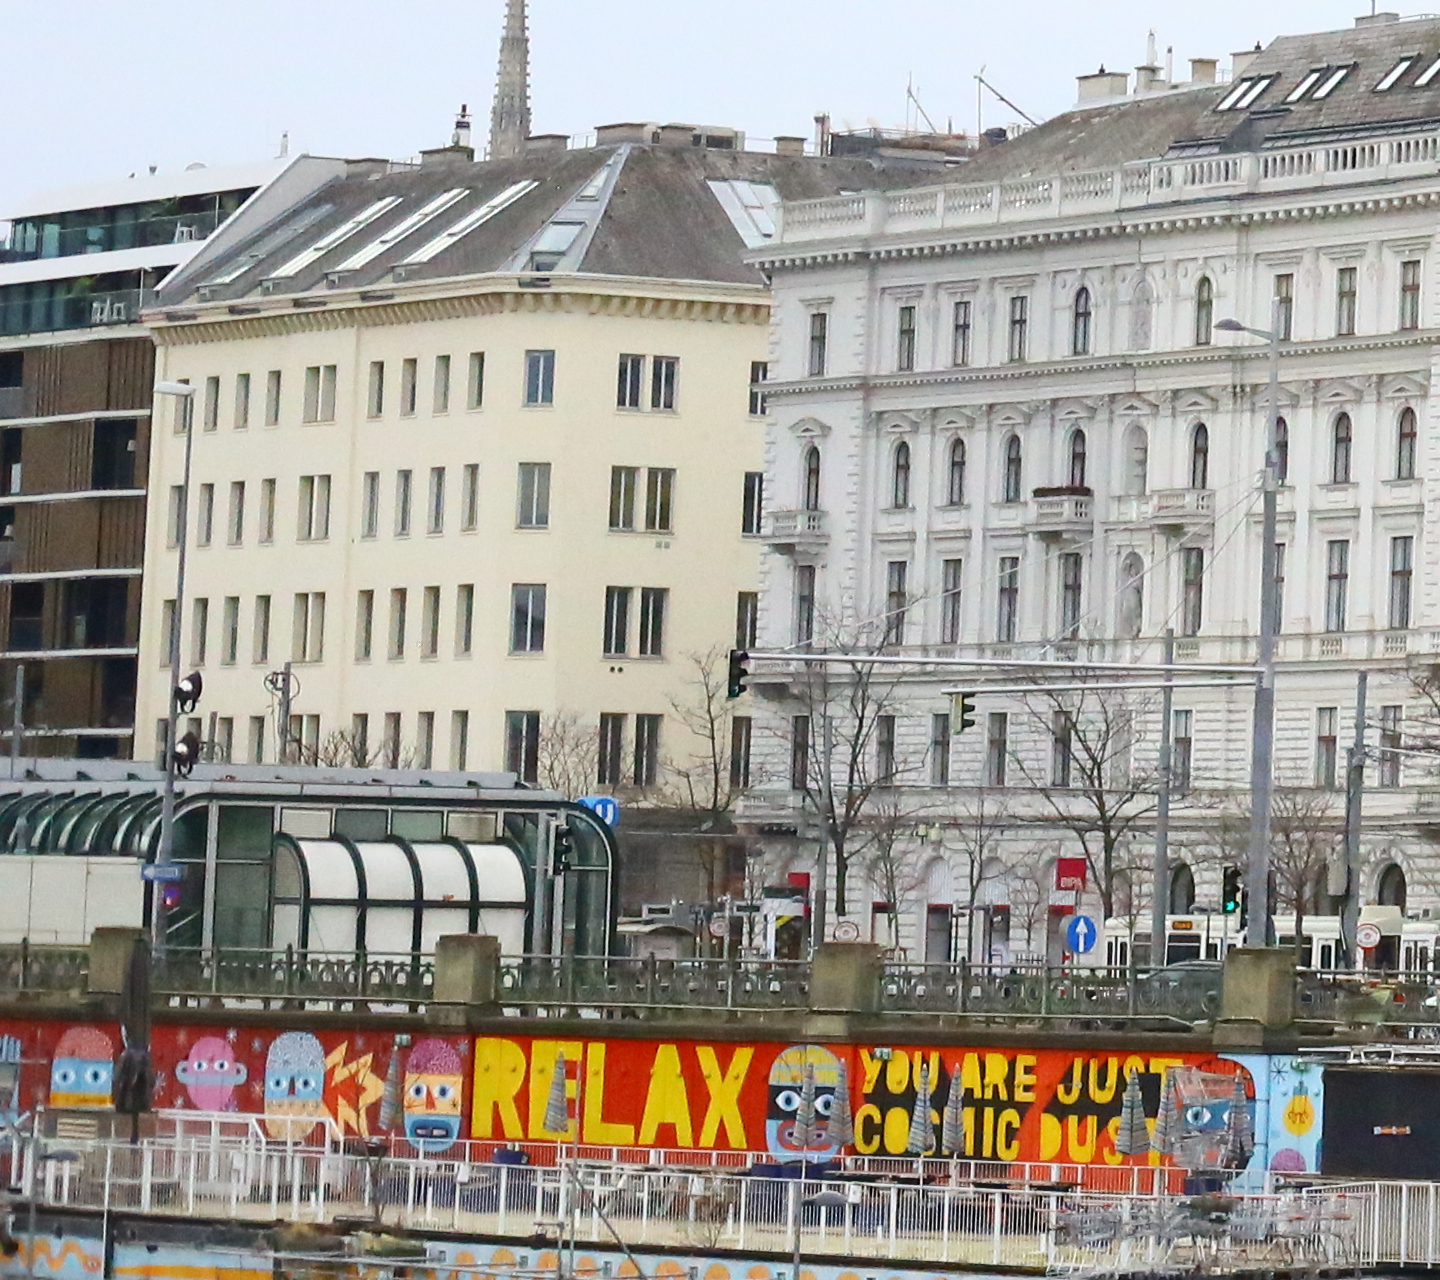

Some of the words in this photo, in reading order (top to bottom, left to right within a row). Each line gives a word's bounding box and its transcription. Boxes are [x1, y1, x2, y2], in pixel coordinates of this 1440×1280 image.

[595, 803, 615, 826] U
[471, 1037, 755, 1149] RELAX
[859, 1048, 941, 1095] YOU
[961, 1052, 1037, 1103] ARE
